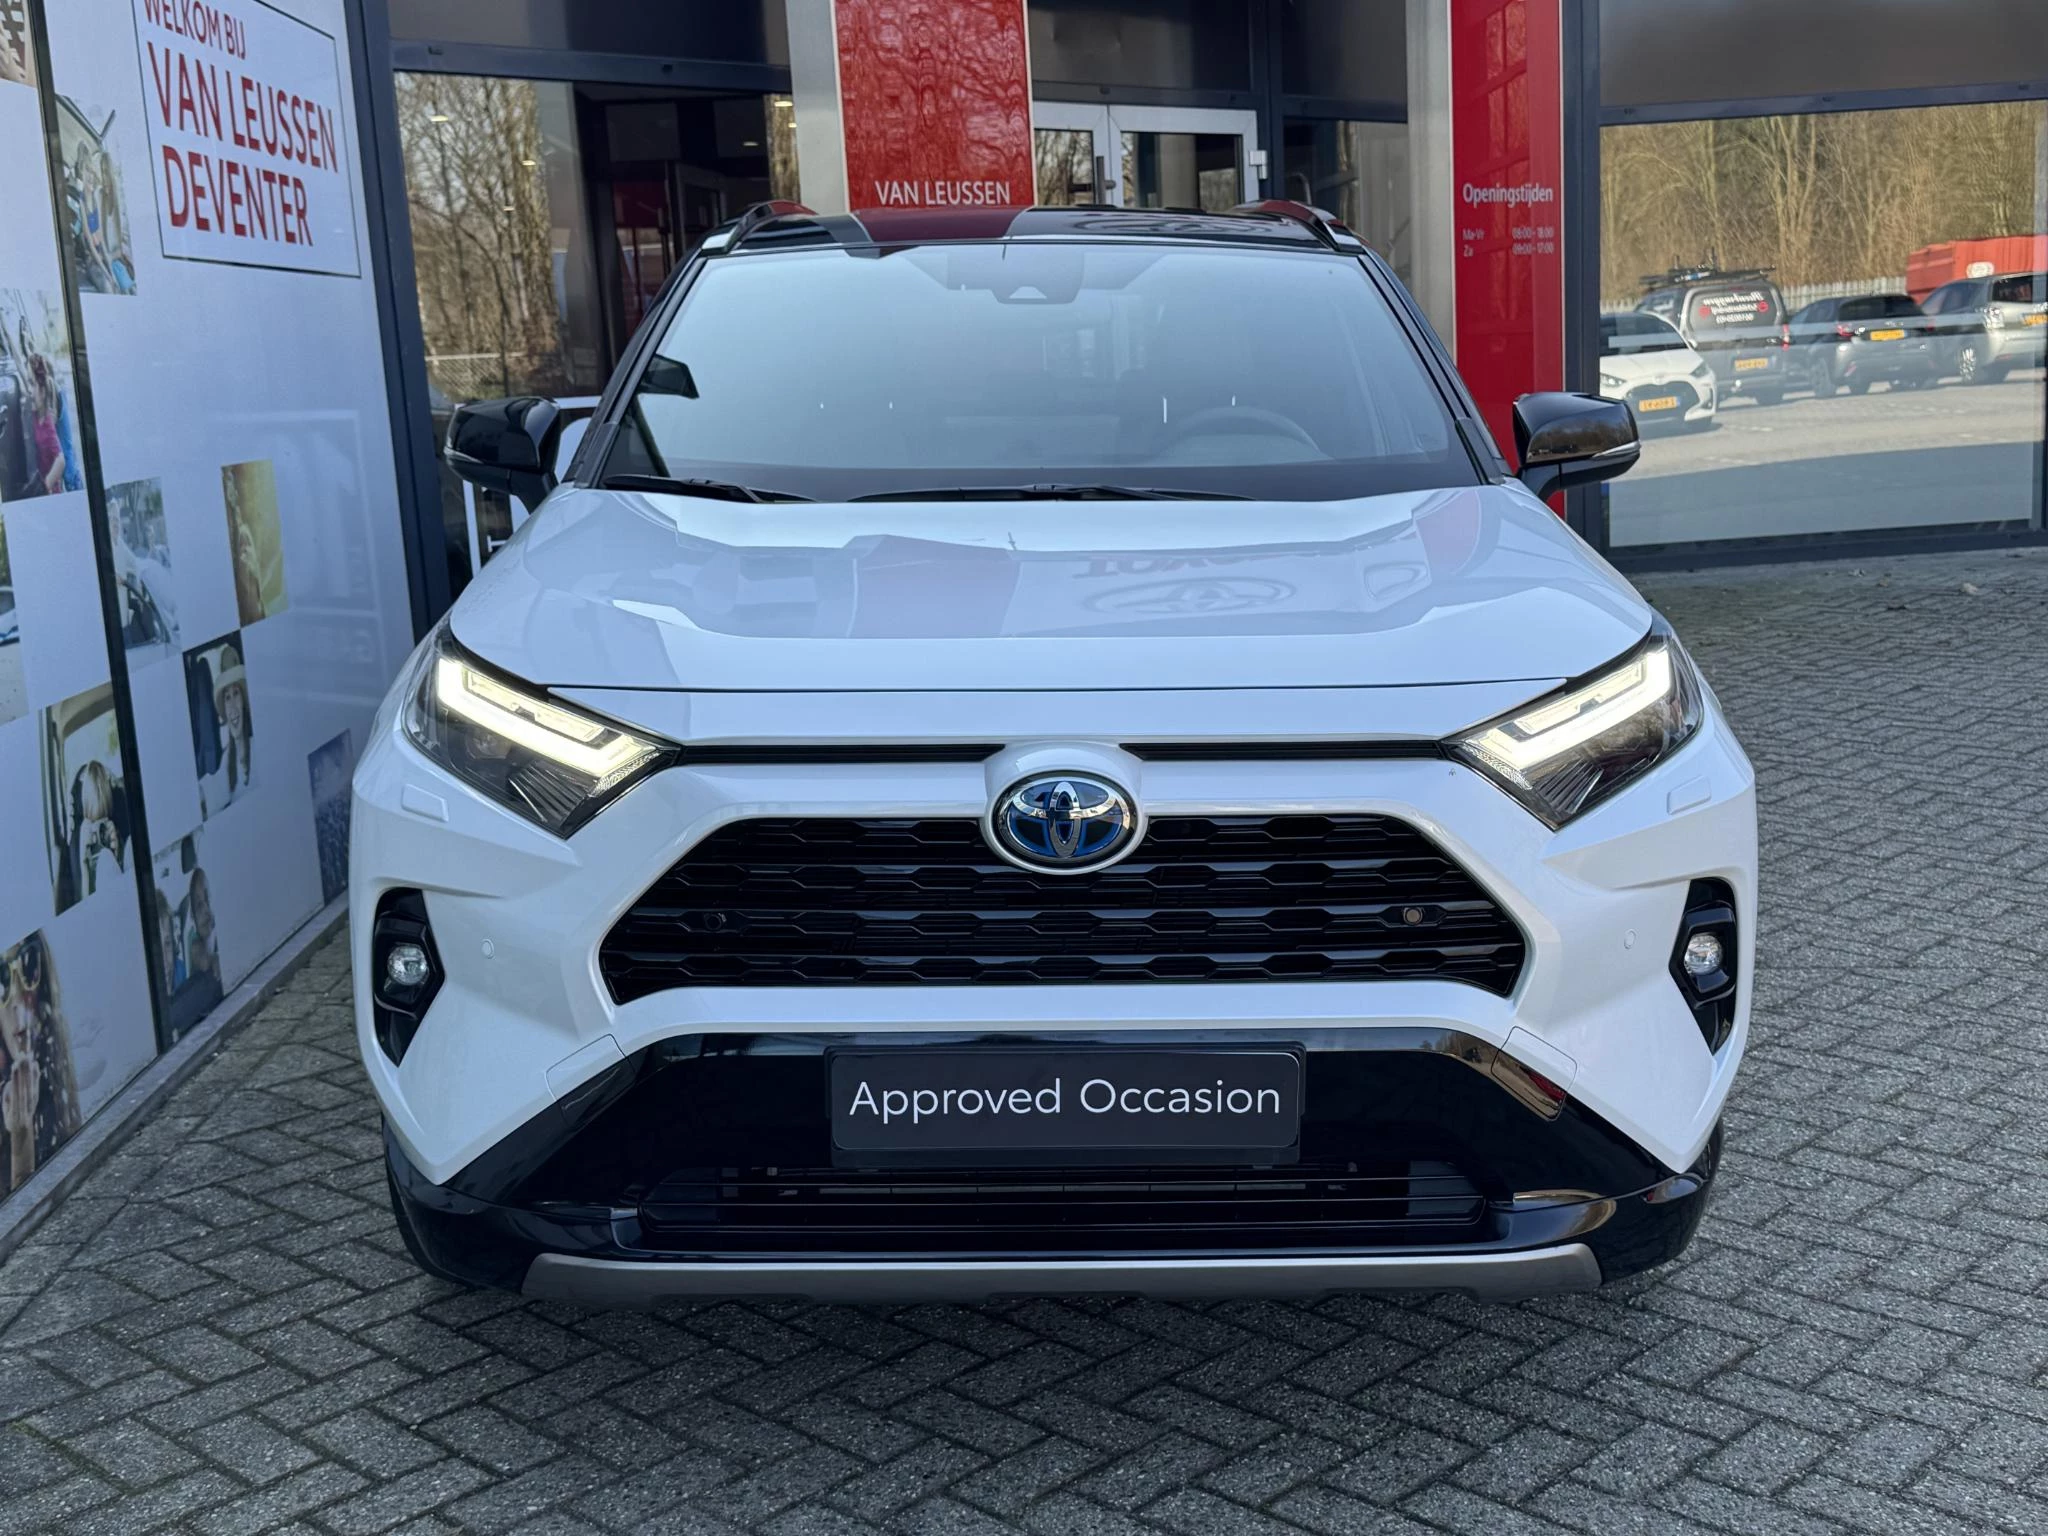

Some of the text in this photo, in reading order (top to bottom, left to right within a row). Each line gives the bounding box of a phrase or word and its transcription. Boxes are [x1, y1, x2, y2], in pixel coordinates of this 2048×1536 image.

[224, 13, 247, 60] BIJ
[147, 41, 339, 173] VAN LEUSSEN
[162, 145, 314, 246] DEVENTER
[875, 180, 1011, 205] VAN LEUSSEN
[1462, 182, 1554, 208] Openingstijden
[849, 1078, 1280, 1124] Approved Occasion
